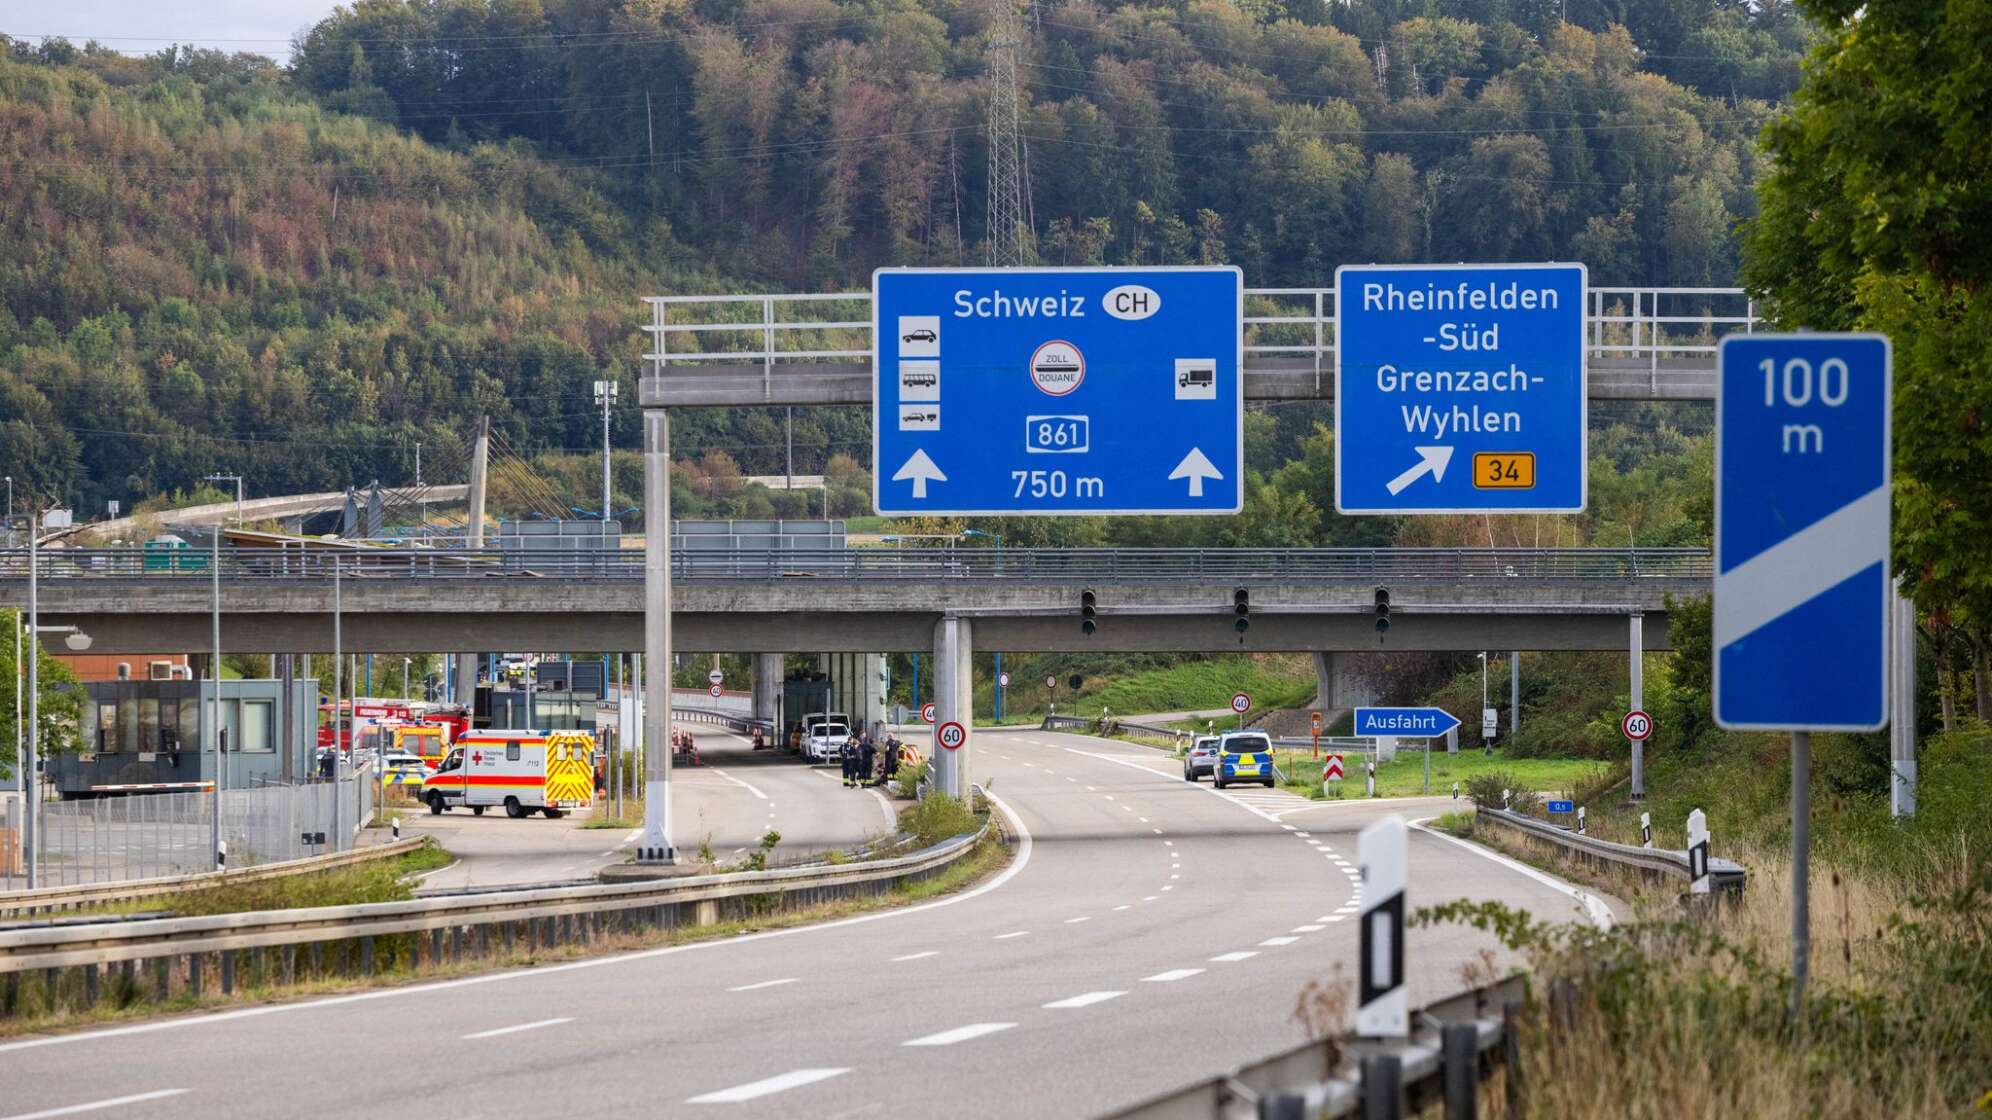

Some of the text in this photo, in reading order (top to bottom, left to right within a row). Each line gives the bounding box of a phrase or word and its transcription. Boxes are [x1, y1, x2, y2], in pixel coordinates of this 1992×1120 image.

[954, 290, 1086, 318] Schweiz
[1115, 292, 1148, 313] CH
[1363, 283, 1559, 311] Rheinfelden
[1423, 323, 1499, 351] -Süd
[1046, 354, 1069, 363] ZOLL
[1039, 373, 1077, 382] DOUANE
[1377, 364, 1544, 392] Grenzach-
[1758, 357, 1849, 408] 100
[1402, 405, 1521, 440] Wyhlen
[1038, 423, 1078, 446] 861
[1782, 424, 1823, 454] m
[1488, 460, 1520, 482] 34
[1011, 471, 1104, 498] 750 m
[1235, 699, 1247, 708] 40
[1365, 714, 1437, 729] Ausfahrt
[1629, 719, 1646, 733] 60
[943, 729, 960, 743] 60
